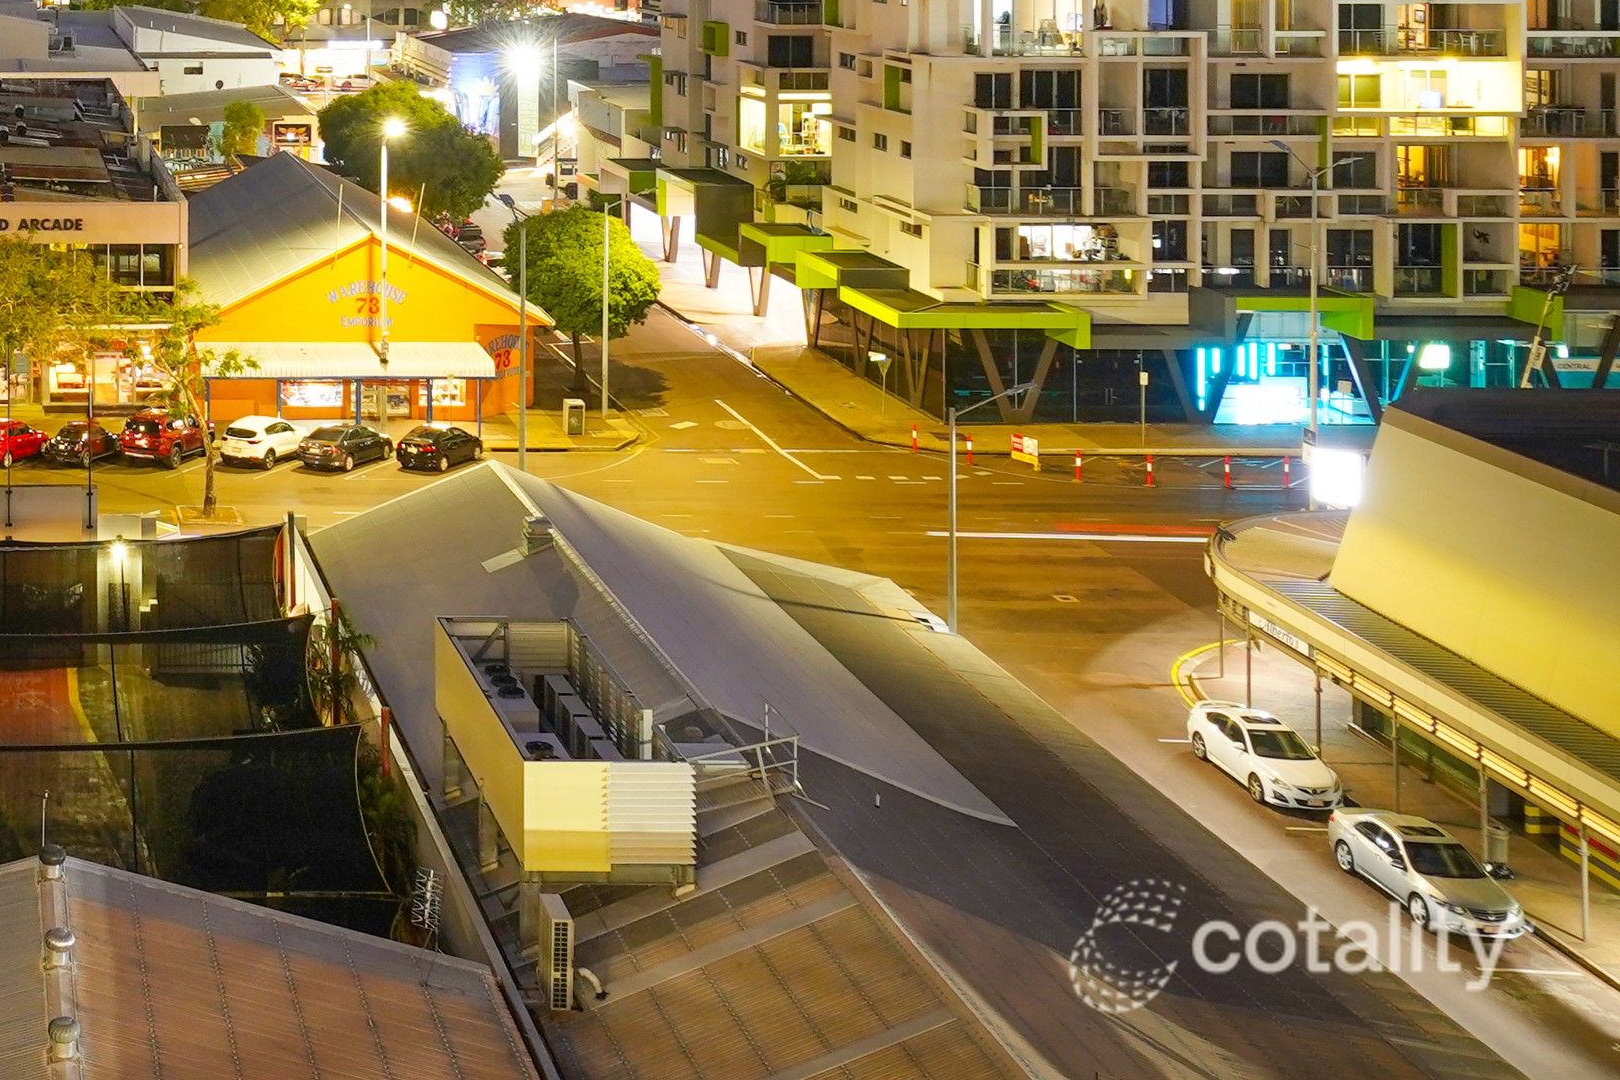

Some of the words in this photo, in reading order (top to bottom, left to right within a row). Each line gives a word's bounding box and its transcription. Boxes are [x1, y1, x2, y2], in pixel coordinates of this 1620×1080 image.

[18, 219, 83, 231] ARCADE
[356, 296, 380, 314] 73
[495, 350, 511, 369] 73
